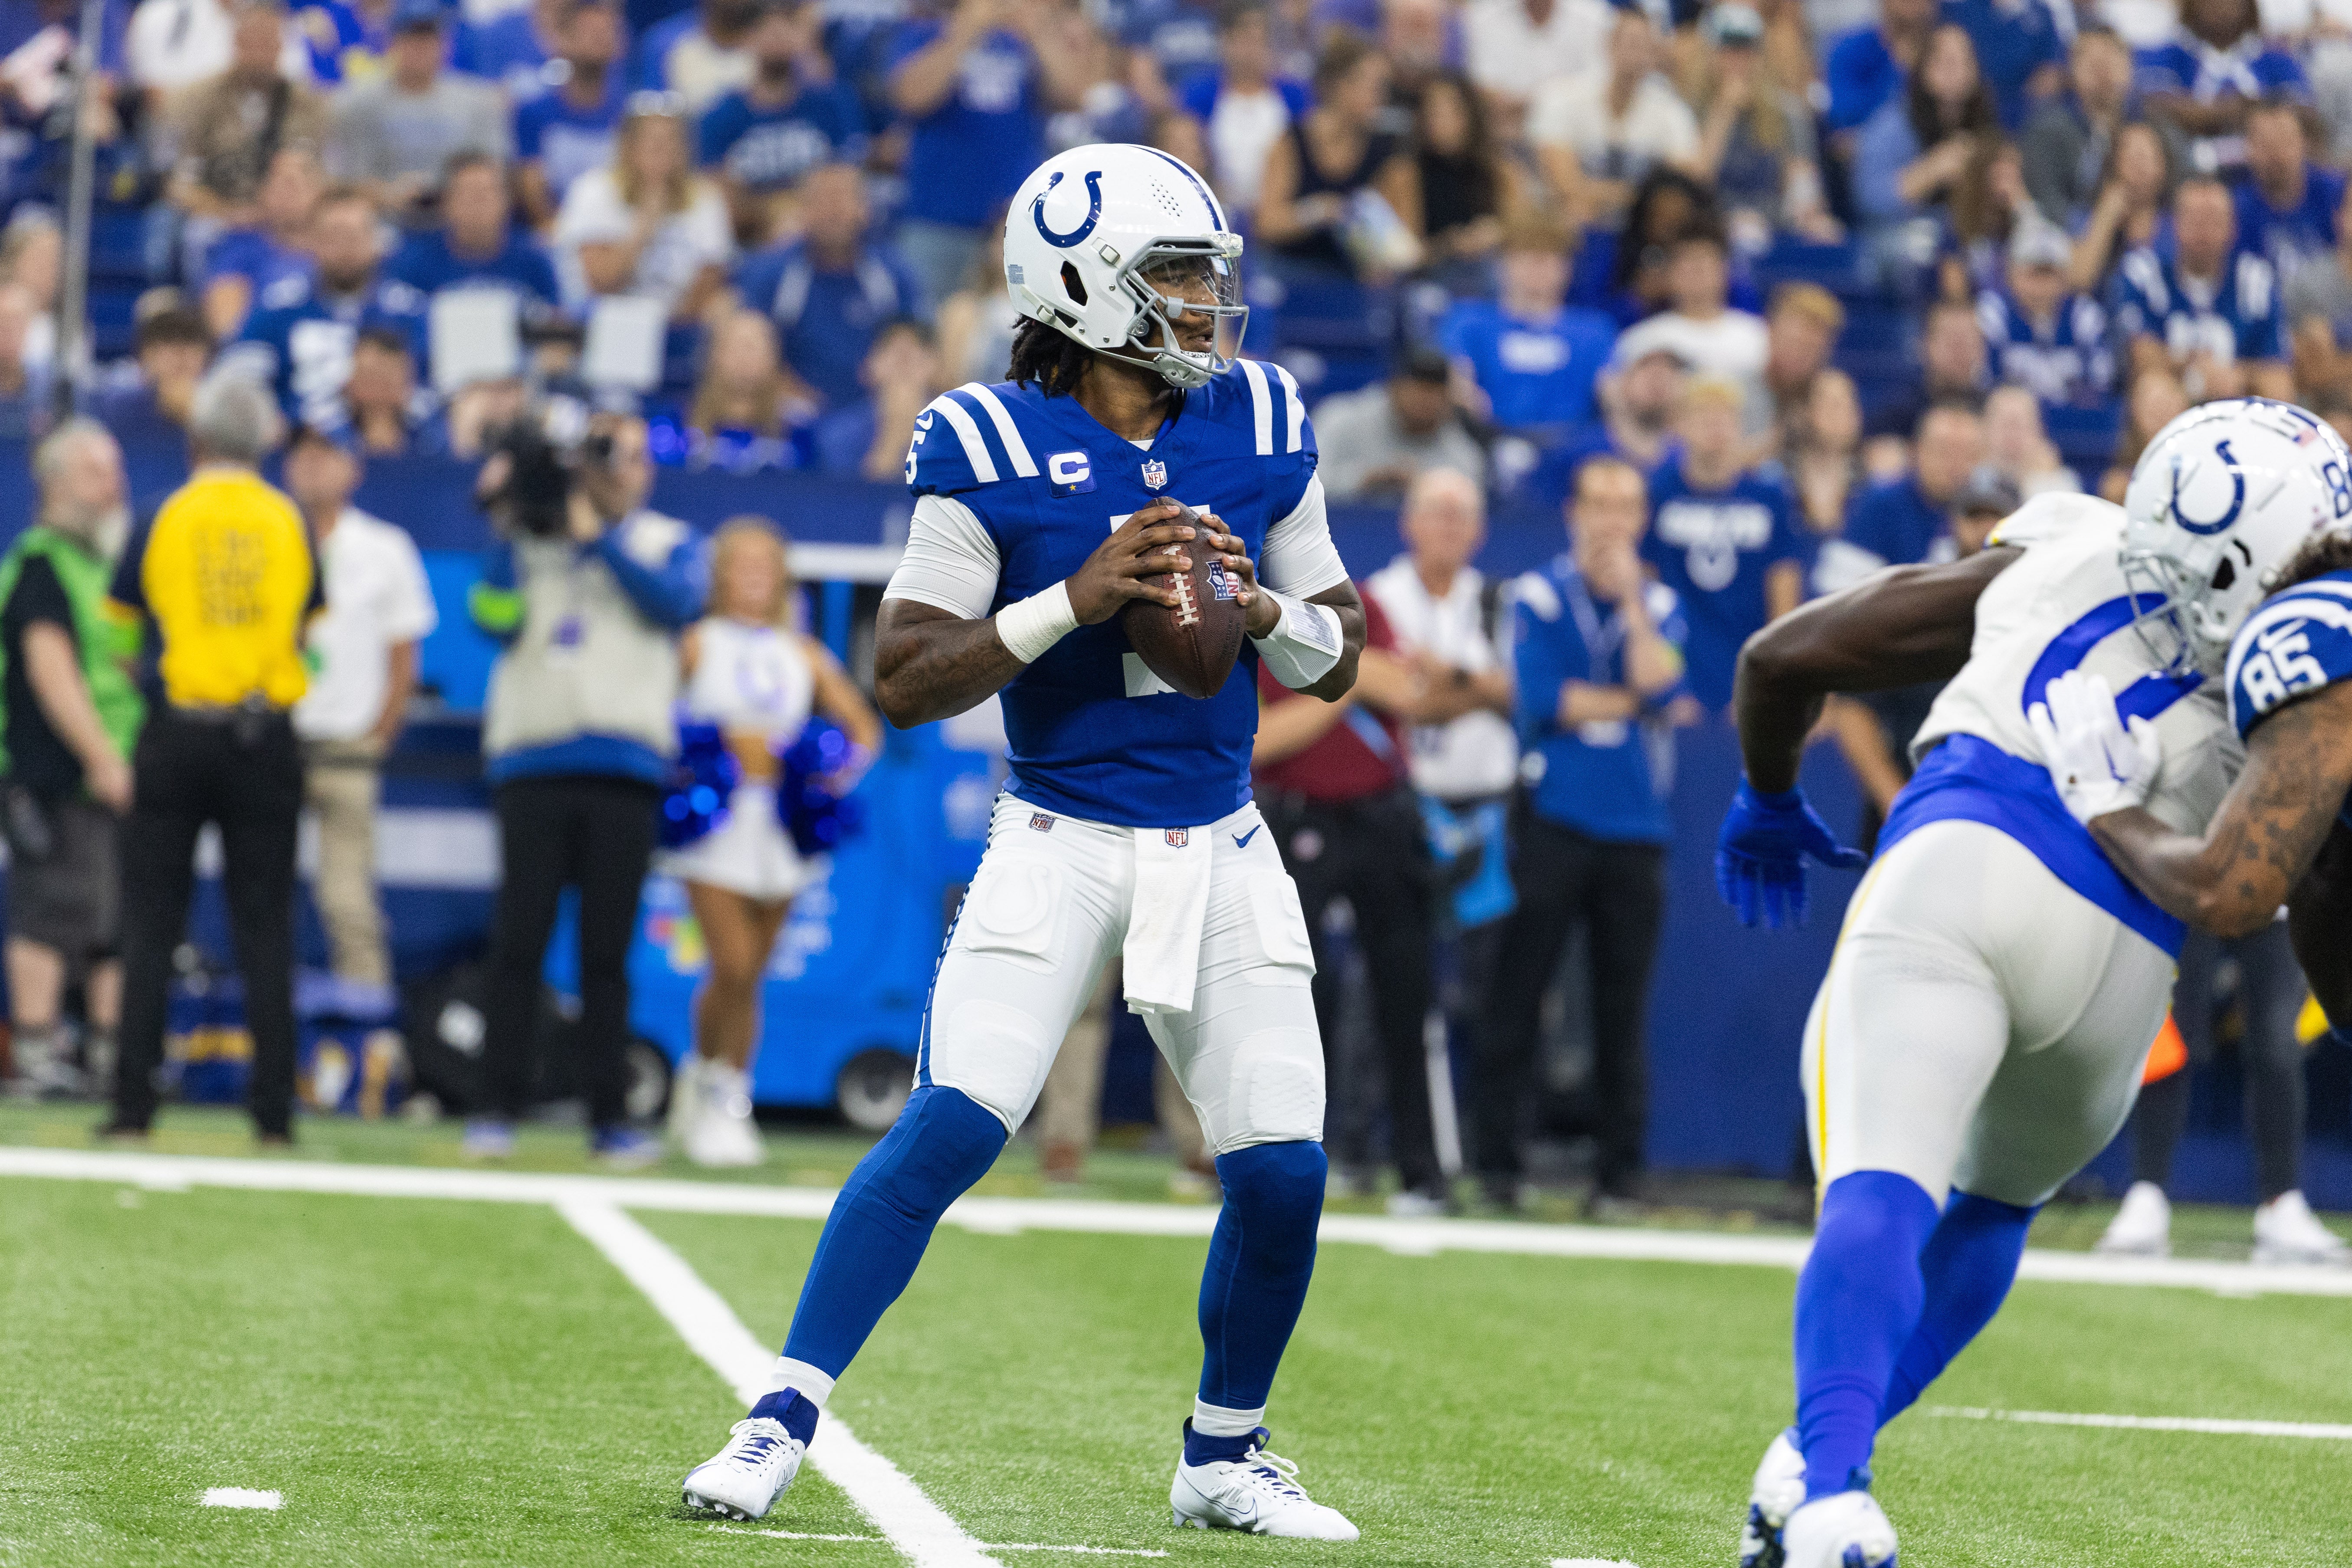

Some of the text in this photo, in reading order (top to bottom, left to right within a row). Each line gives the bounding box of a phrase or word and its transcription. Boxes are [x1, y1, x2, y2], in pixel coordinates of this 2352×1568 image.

[1049, 452, 1090, 485] C
[1148, 472, 1164, 484] NFL
[2241, 632, 2328, 712] 85
[1032, 818, 1048, 829] NFL
[1168, 831, 1186, 845] NFL
